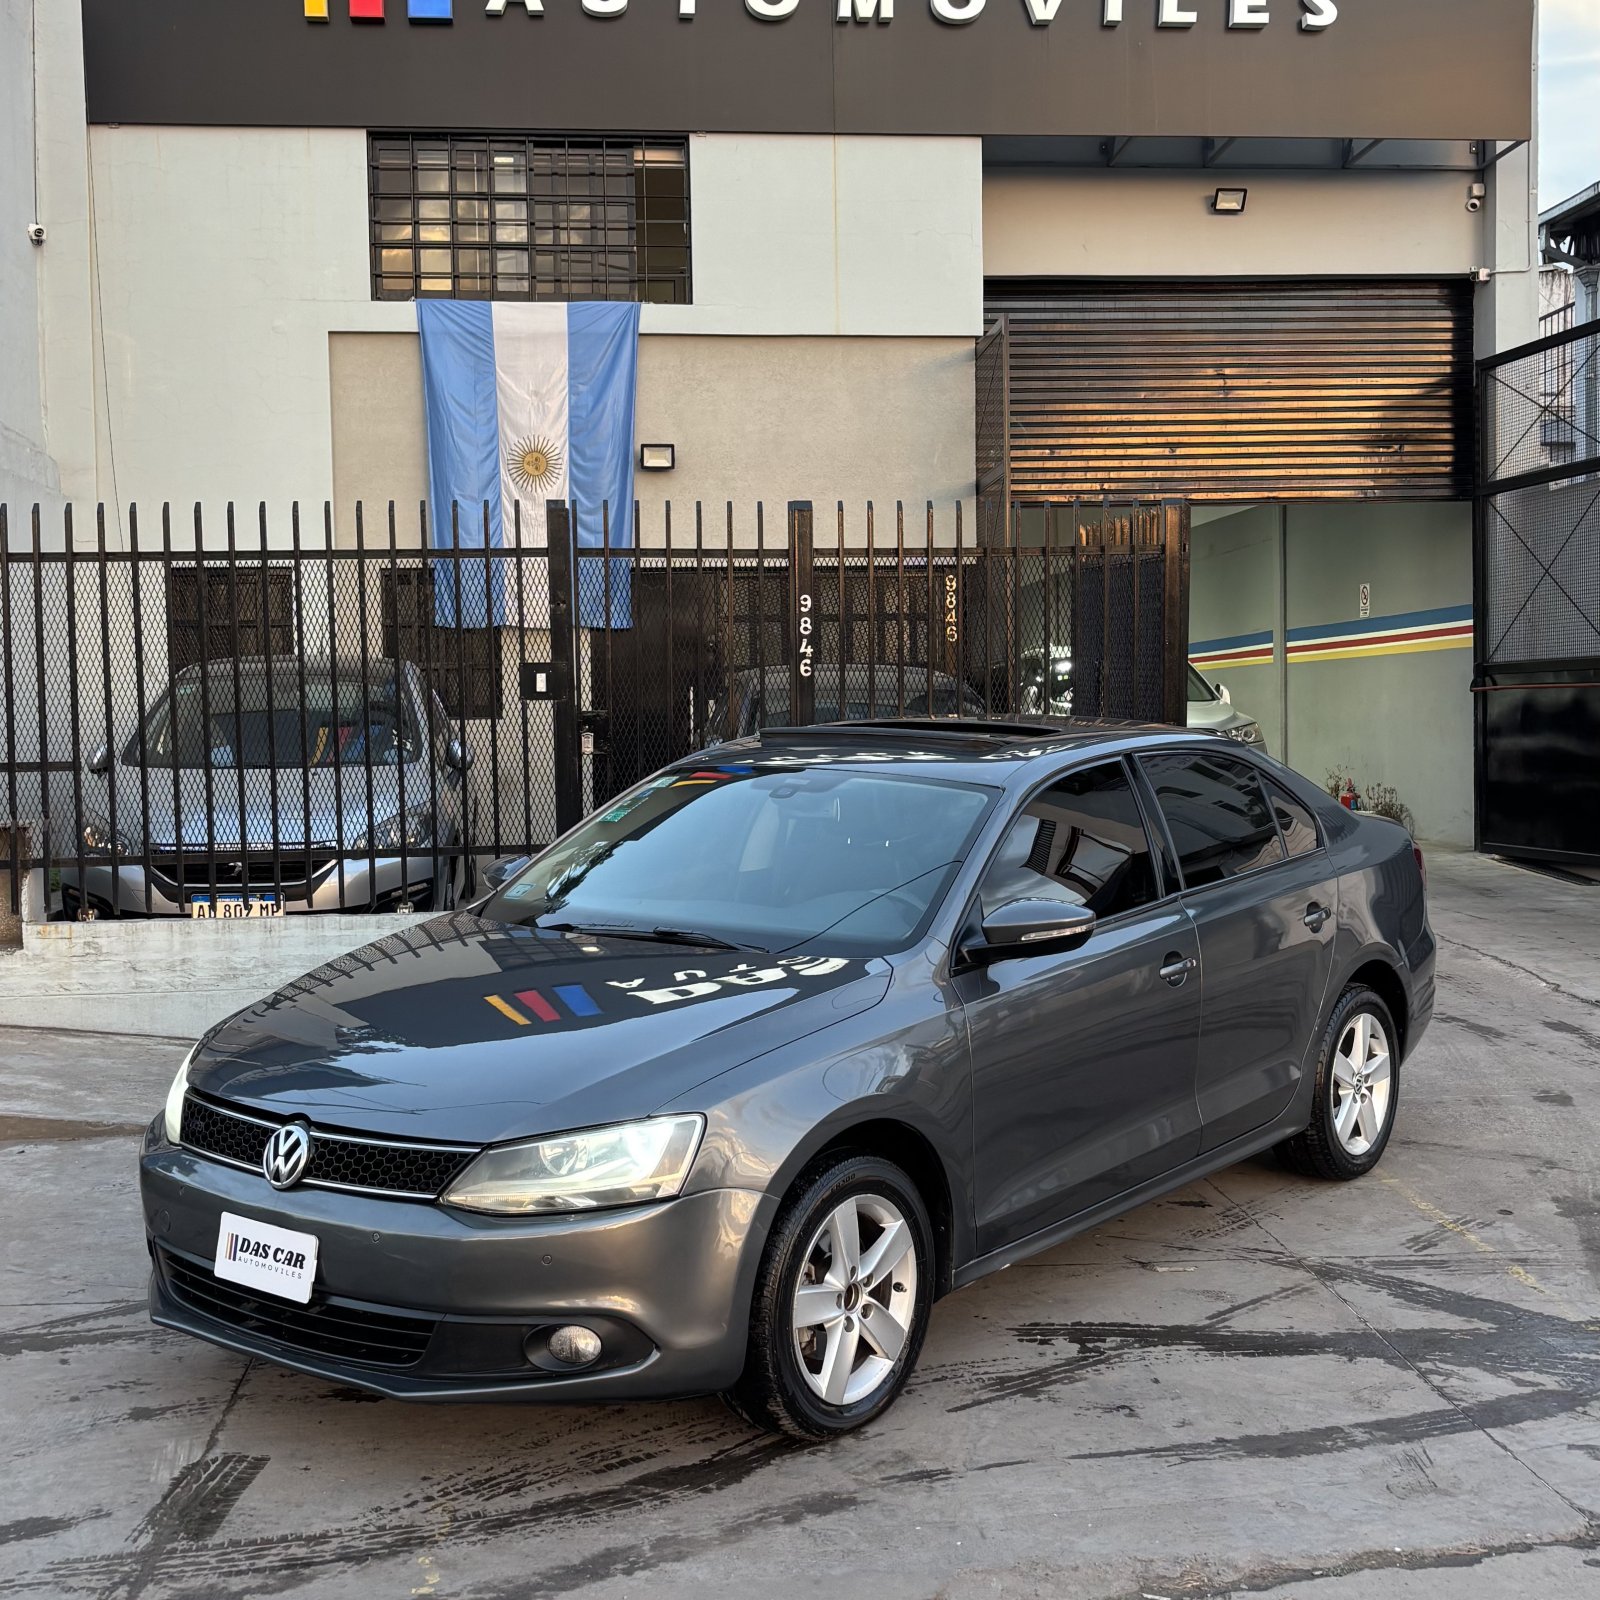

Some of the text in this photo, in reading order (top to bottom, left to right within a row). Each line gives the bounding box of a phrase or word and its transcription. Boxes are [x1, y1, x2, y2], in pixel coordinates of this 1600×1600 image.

[945, 574, 957, 642] 9846
[799, 594, 813, 677] 9846
[237, 1256, 303, 1279] AUTOMOVILES
[239, 1237, 306, 1270] DAS CAR
